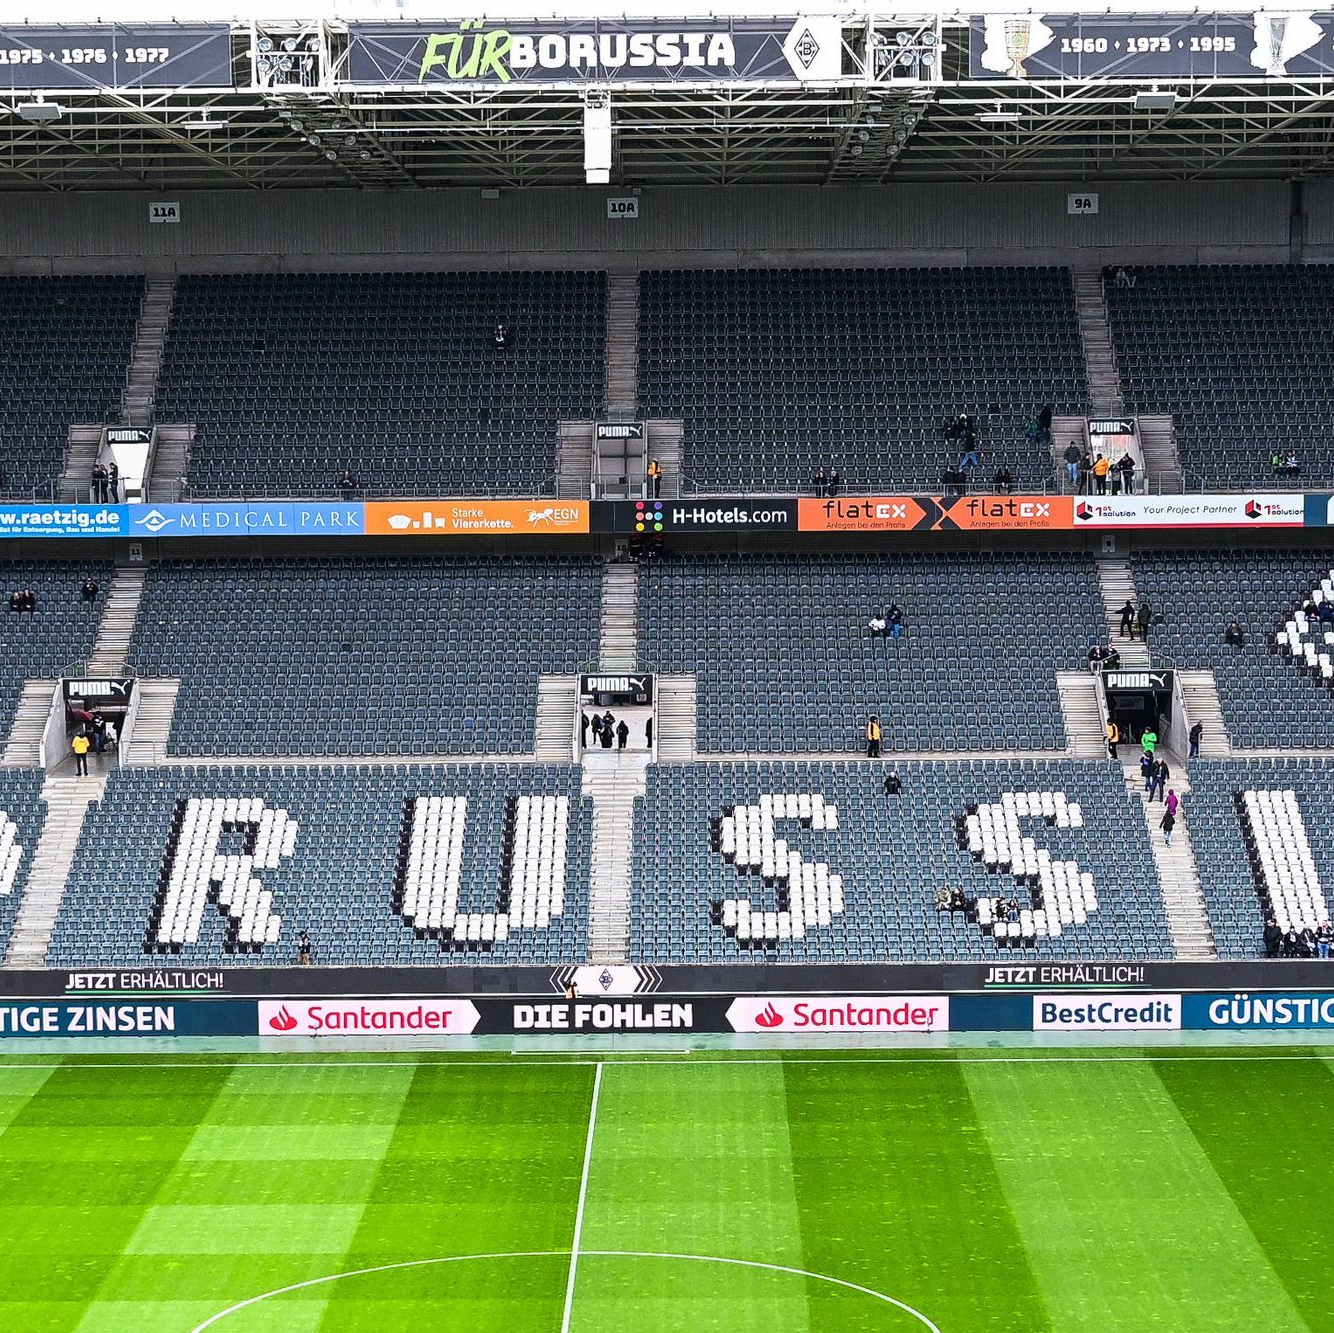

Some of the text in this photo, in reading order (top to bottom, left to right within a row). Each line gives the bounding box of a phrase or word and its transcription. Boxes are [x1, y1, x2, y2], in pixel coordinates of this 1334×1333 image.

[1060, 36, 1236, 54] 1960 1973 1995
[61, 47, 107, 65] 1976
[124, 47, 170, 64] 1977
[610, 201, 635, 214] 10A
[1074, 197, 1092, 210] 9A
[153, 206, 176, 219] 11A
[598, 426, 630, 437] PUMA
[1089, 421, 1121, 433] PUMA
[108, 430, 139, 441] PUMA
[452, 507, 484, 518] Starke
[554, 508, 579, 519] EGN
[672, 506, 788, 524] H-Hotels.com
[1143, 504, 1237, 515] Your Project Partner
[180, 511, 360, 527] MEDICAL PARK
[452, 518, 514, 529] Viererkette.
[826, 521, 855, 529] Anlegen
[970, 520, 999, 528] Anlegen
[587, 677, 629, 692] PUMA
[1107, 673, 1150, 688] PUMA
[69, 681, 111, 696] PUMA
[65, 971, 224, 989] JETZT ERHÄLTLICH!
[984, 964, 1145, 983] JETZT ERHÄLTLICH!
[67, 1005, 176, 1032] ZINSEN
[307, 1005, 453, 1030] Santander
[513, 1003, 694, 1028] DIE FOHLEN
[793, 1002, 939, 1027] Santander
[1041, 1000, 1173, 1024] BestCredit
